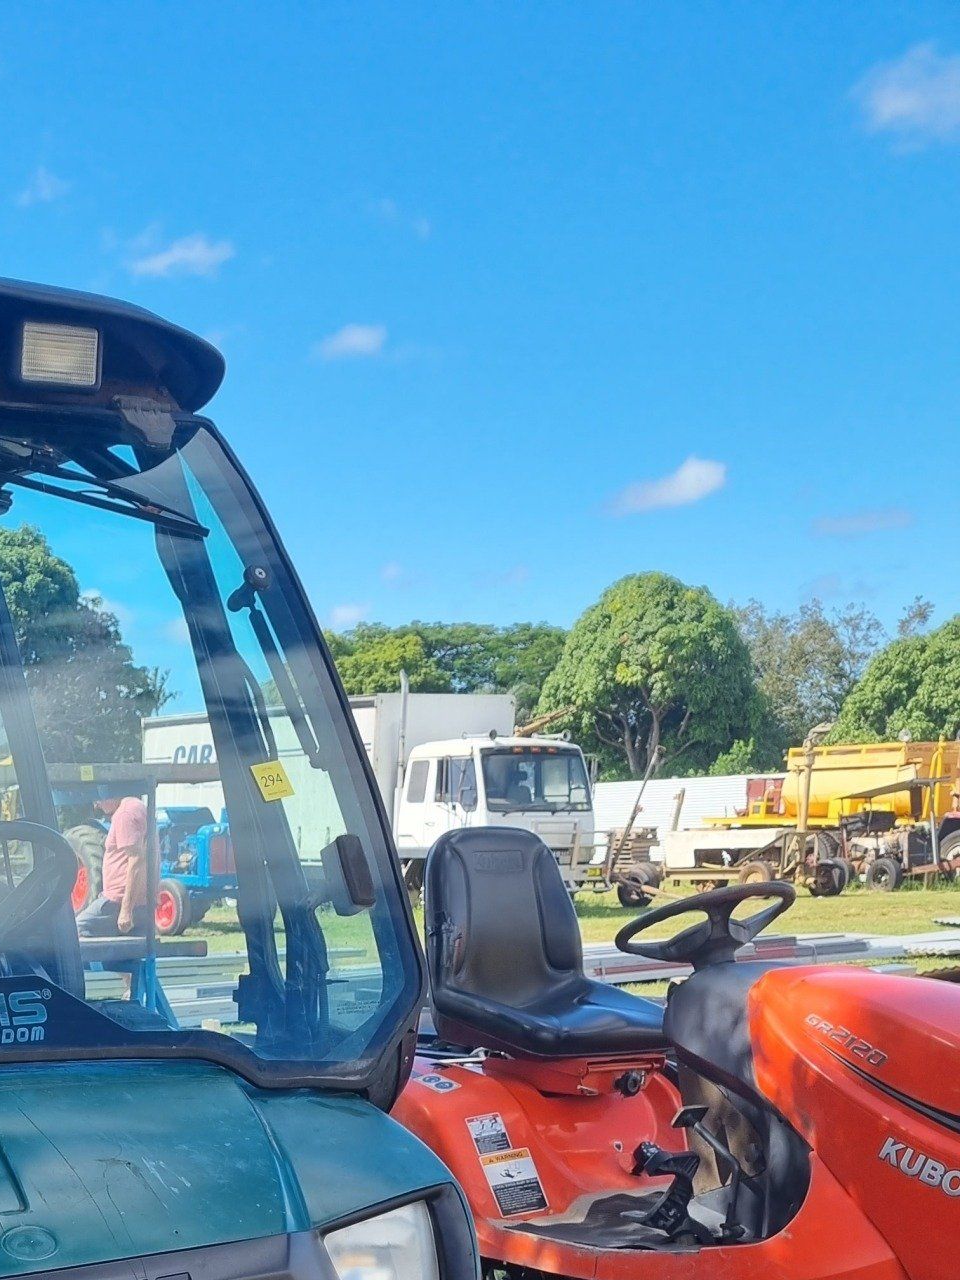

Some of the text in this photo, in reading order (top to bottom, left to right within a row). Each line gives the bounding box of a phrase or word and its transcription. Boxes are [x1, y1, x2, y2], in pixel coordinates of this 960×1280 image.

[260, 773, 283, 788] 294
[804, 1013, 888, 1068] GR2120
[877, 1135, 960, 1198] KUBO
